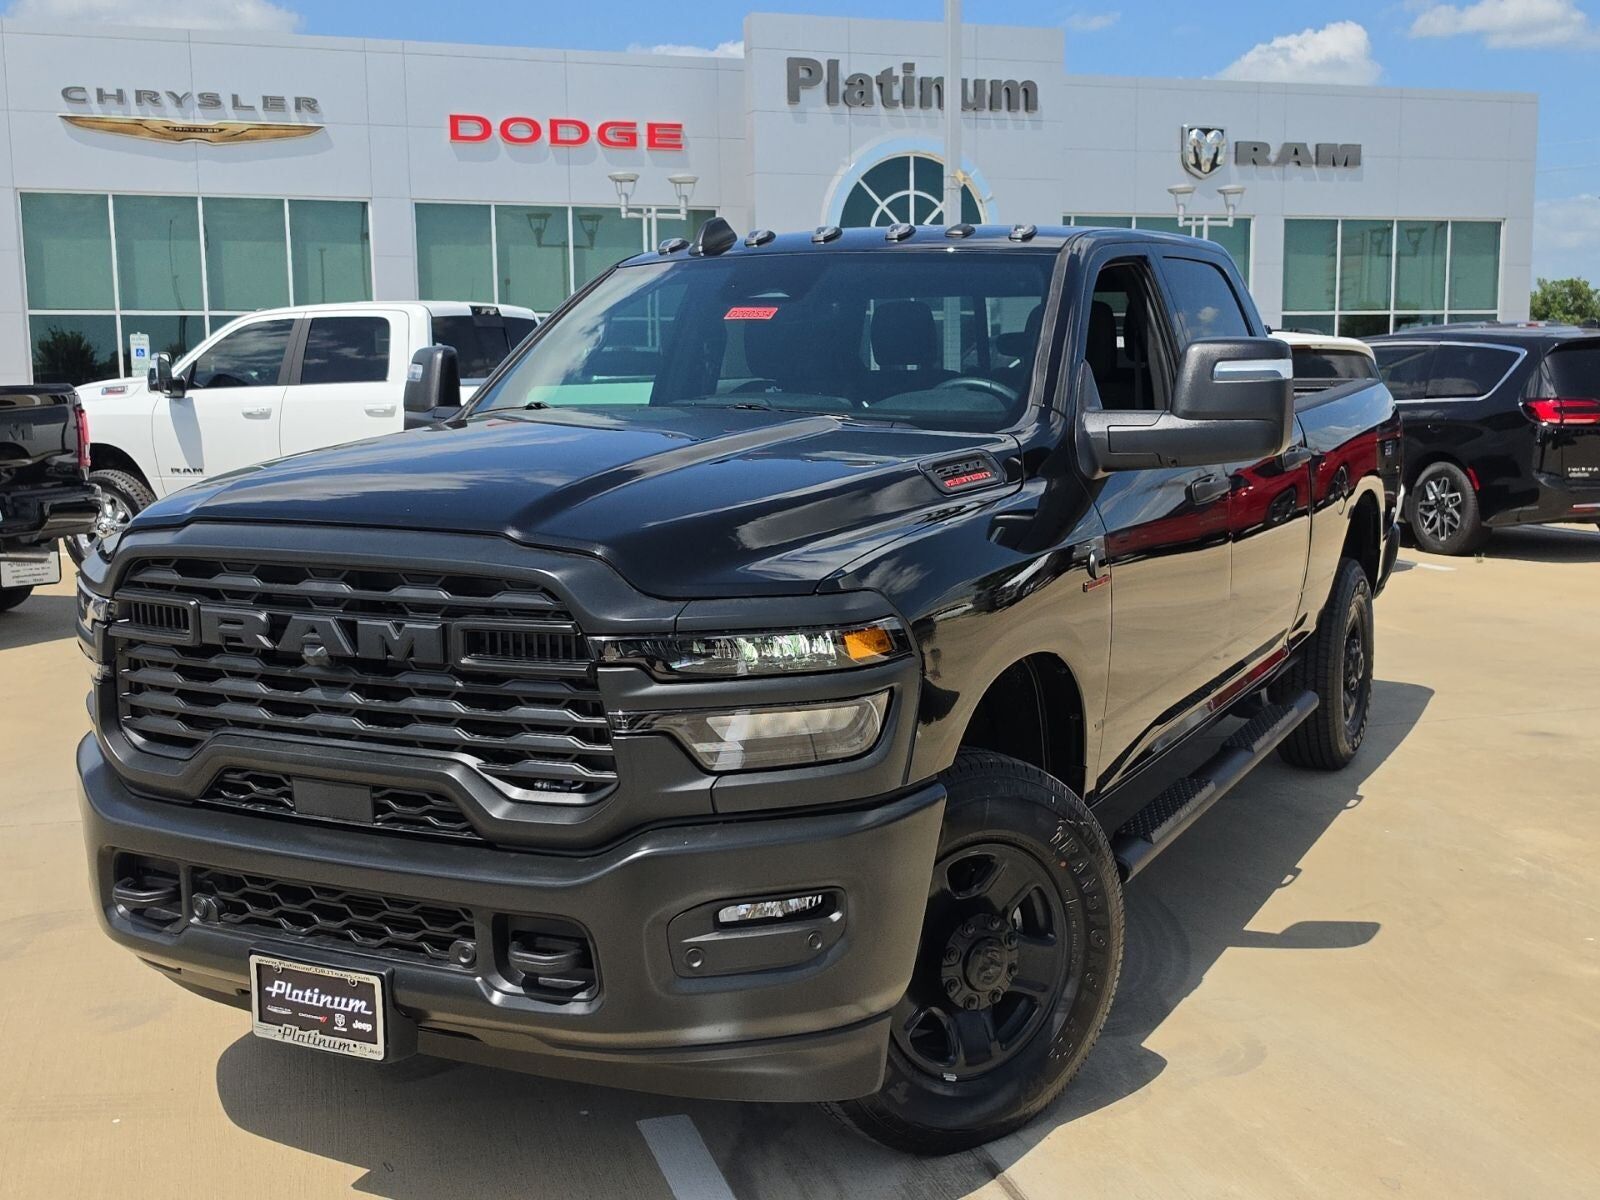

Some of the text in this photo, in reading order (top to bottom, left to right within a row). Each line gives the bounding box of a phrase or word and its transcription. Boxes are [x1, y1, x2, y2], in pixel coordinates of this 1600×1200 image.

[786, 56, 1039, 113] Platinum
[60, 86, 320, 114] CHRYSLER
[449, 114, 684, 151] DODGE
[1235, 141, 1362, 168] RAM
[170, 467, 204, 475] RAM
[200, 606, 444, 666] RAM
[265, 980, 373, 1015] Platinum
[281, 1026, 356, 1053] Platinum
[352, 1020, 373, 1032] Jeep
